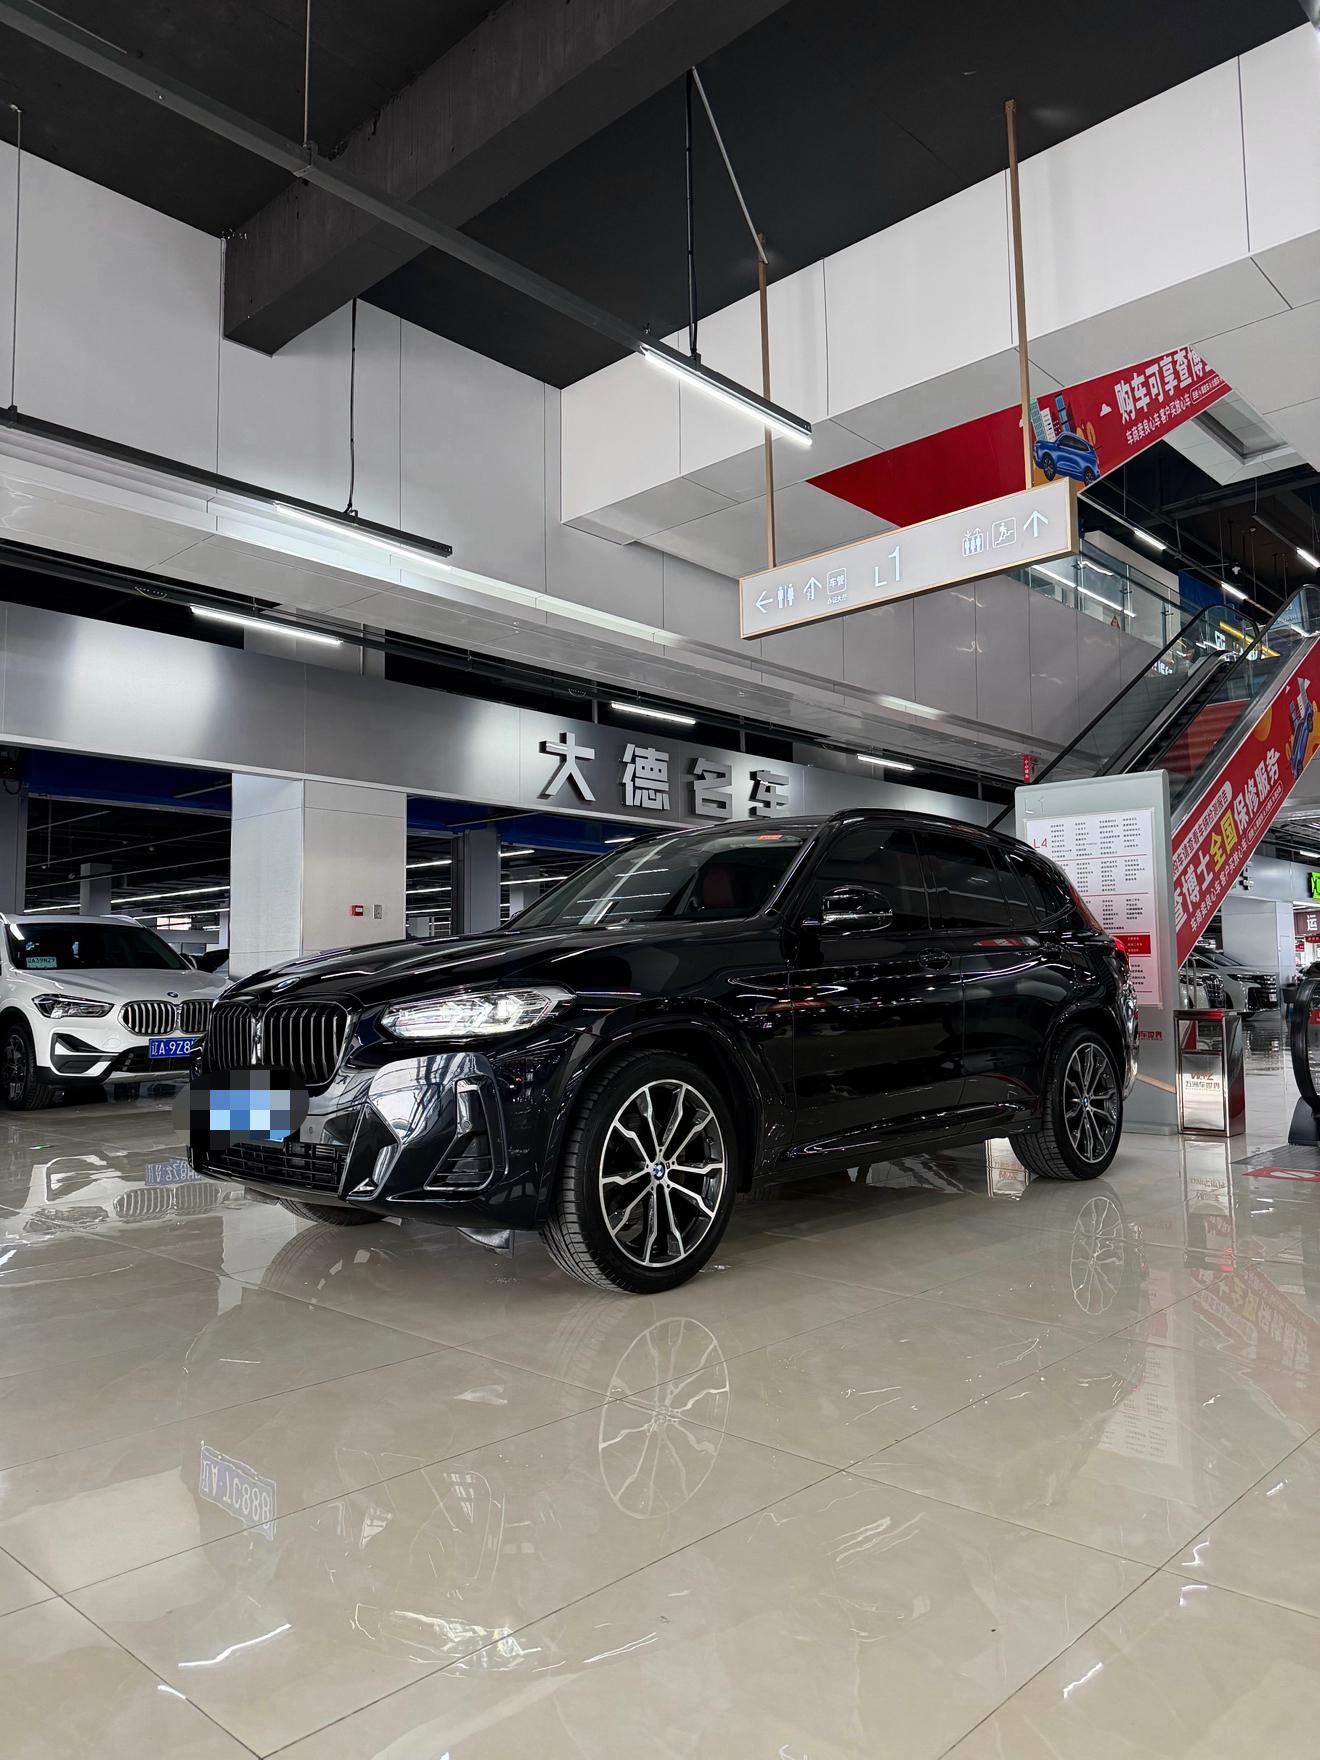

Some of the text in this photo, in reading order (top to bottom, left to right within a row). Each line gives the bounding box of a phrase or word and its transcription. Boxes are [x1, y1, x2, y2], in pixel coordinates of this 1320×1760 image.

[1114, 347, 1214, 424] 购车可享查博
[875, 546, 901, 588] L1
[538, 731, 790, 819] 大德名车
[151, 1041, 193, 1056] 辽A·9Z8
